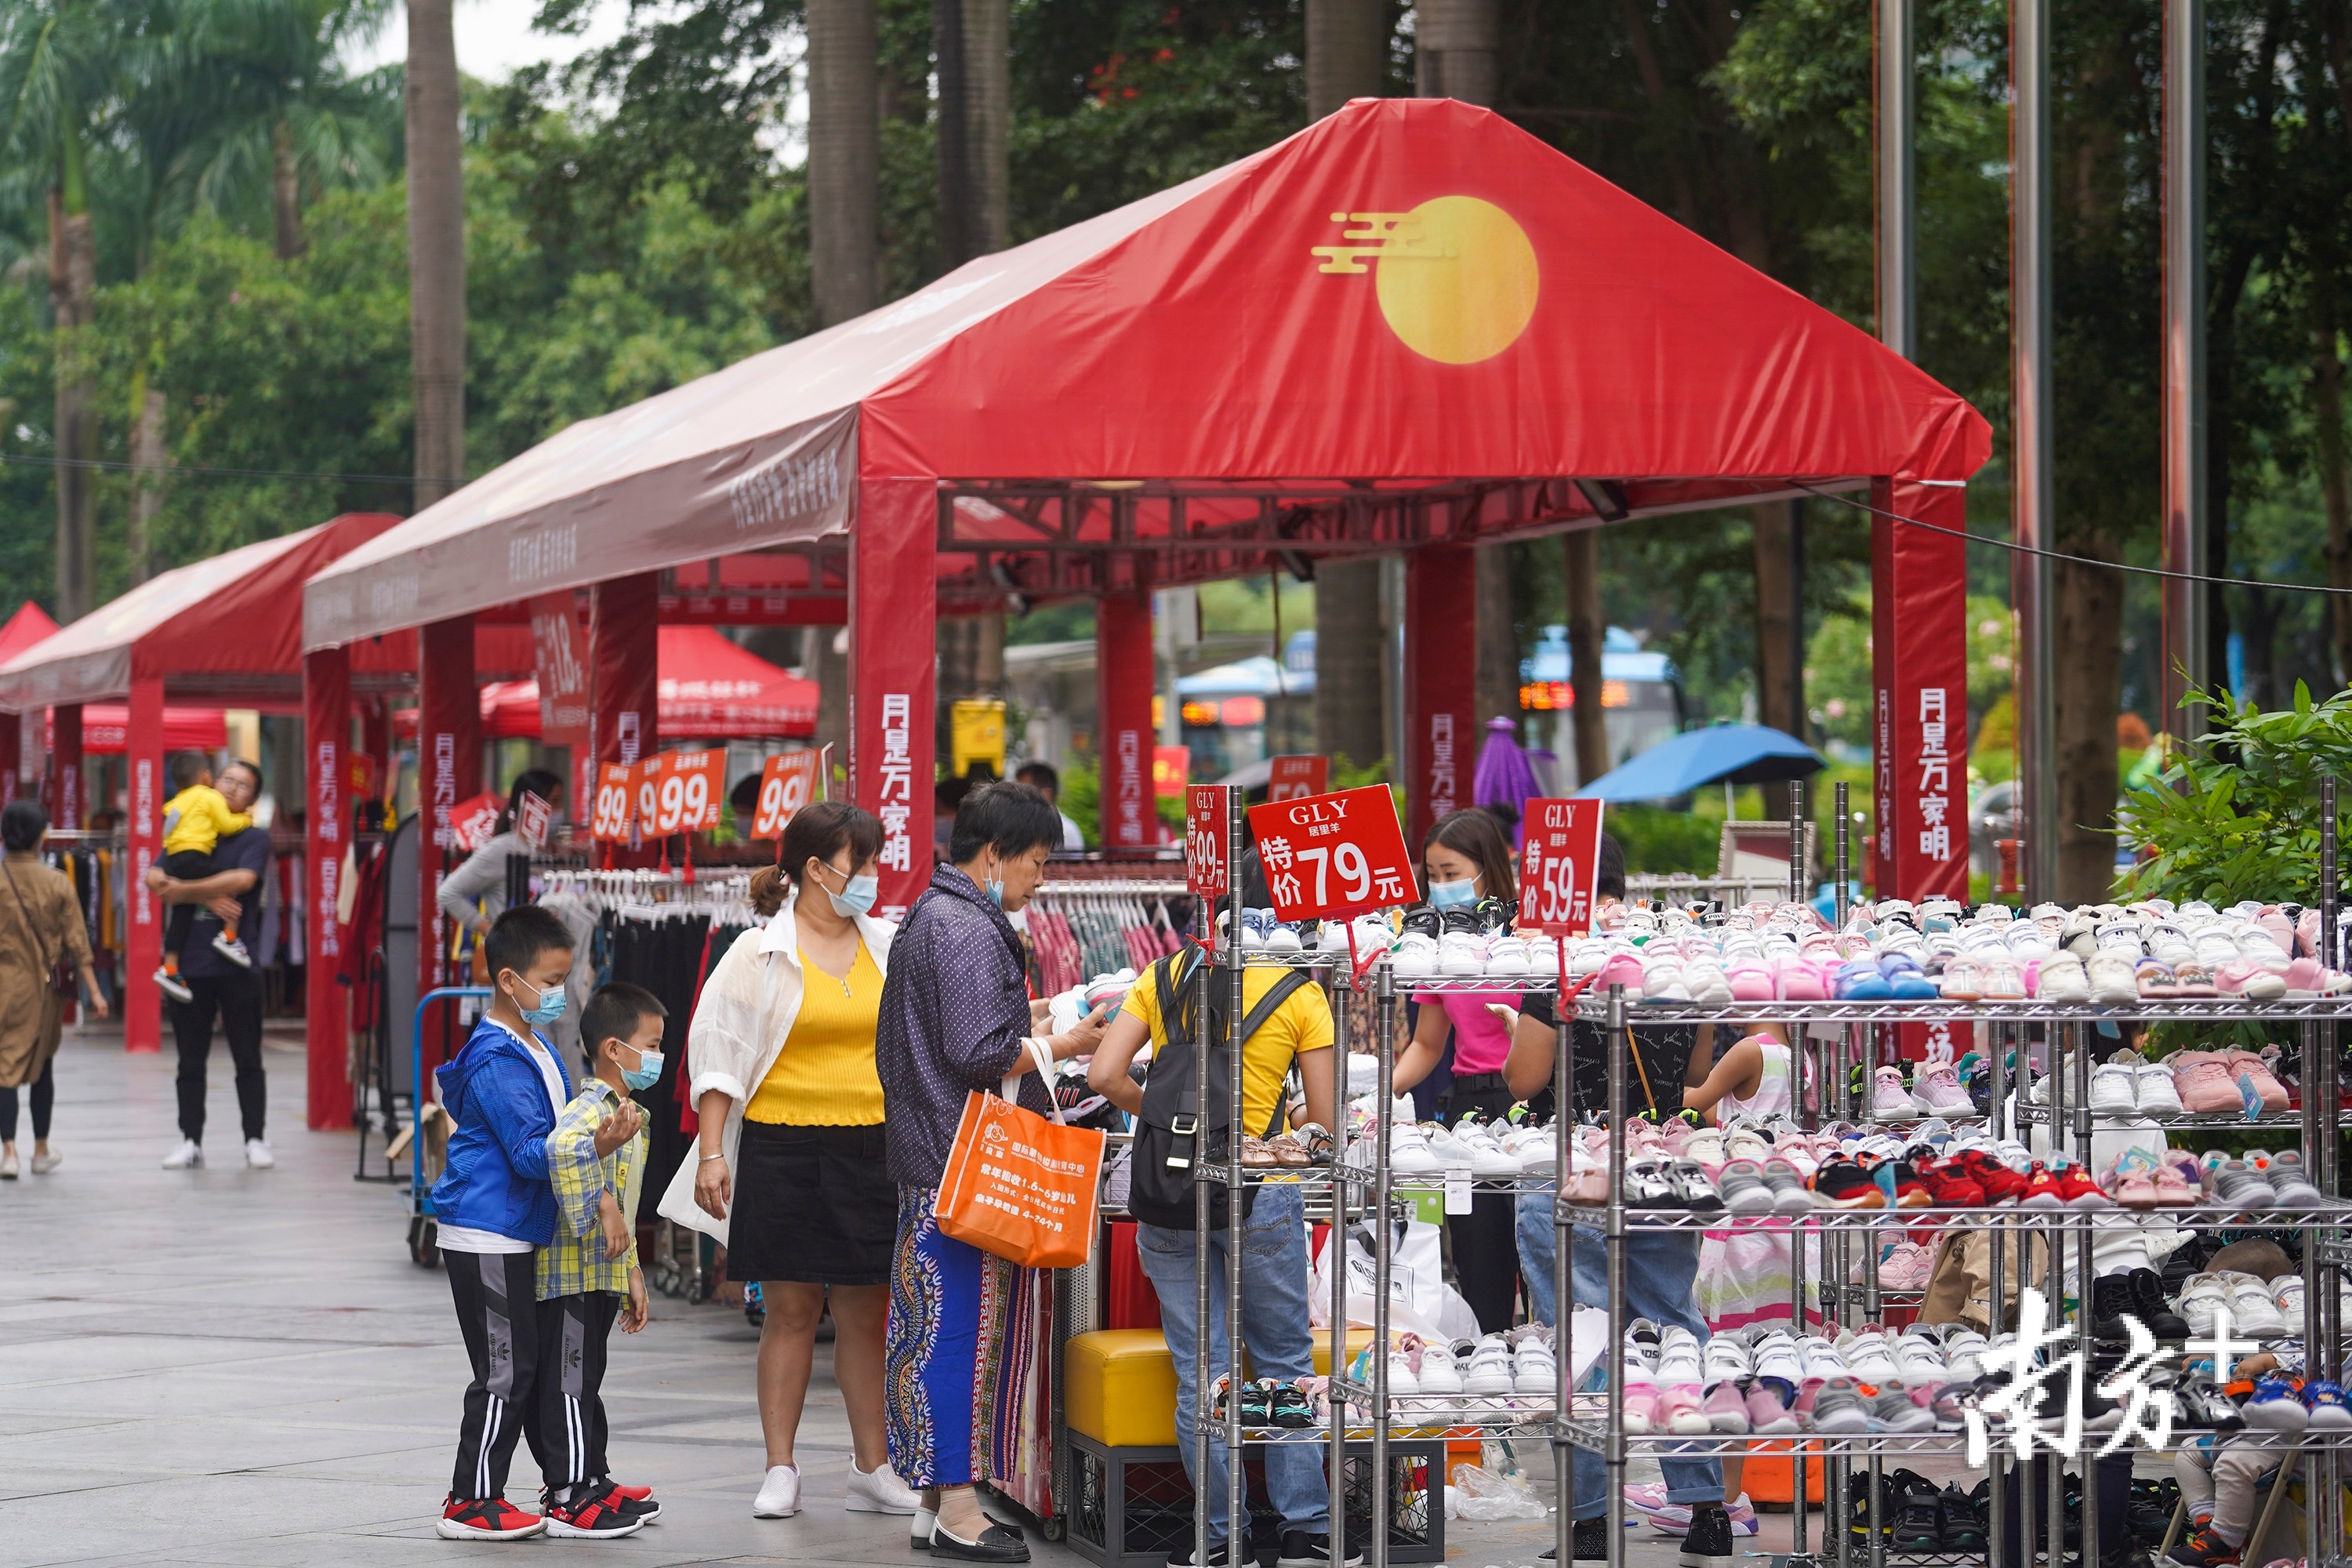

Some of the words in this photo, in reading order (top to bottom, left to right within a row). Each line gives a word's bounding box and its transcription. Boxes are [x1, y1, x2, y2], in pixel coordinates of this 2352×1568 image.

[880, 694, 911, 872] 月是万家明
[1119, 730, 1142, 844] 月是万家明
[1196, 792, 1214, 817] GLY
[1878, 689, 1891, 861] 月是万家明
[1918, 688, 1951, 861] 月是万家明
[1289, 799, 1348, 825] GLY
[1308, 822, 1341, 837] 居里羊
[1544, 804, 1577, 828] GLY
